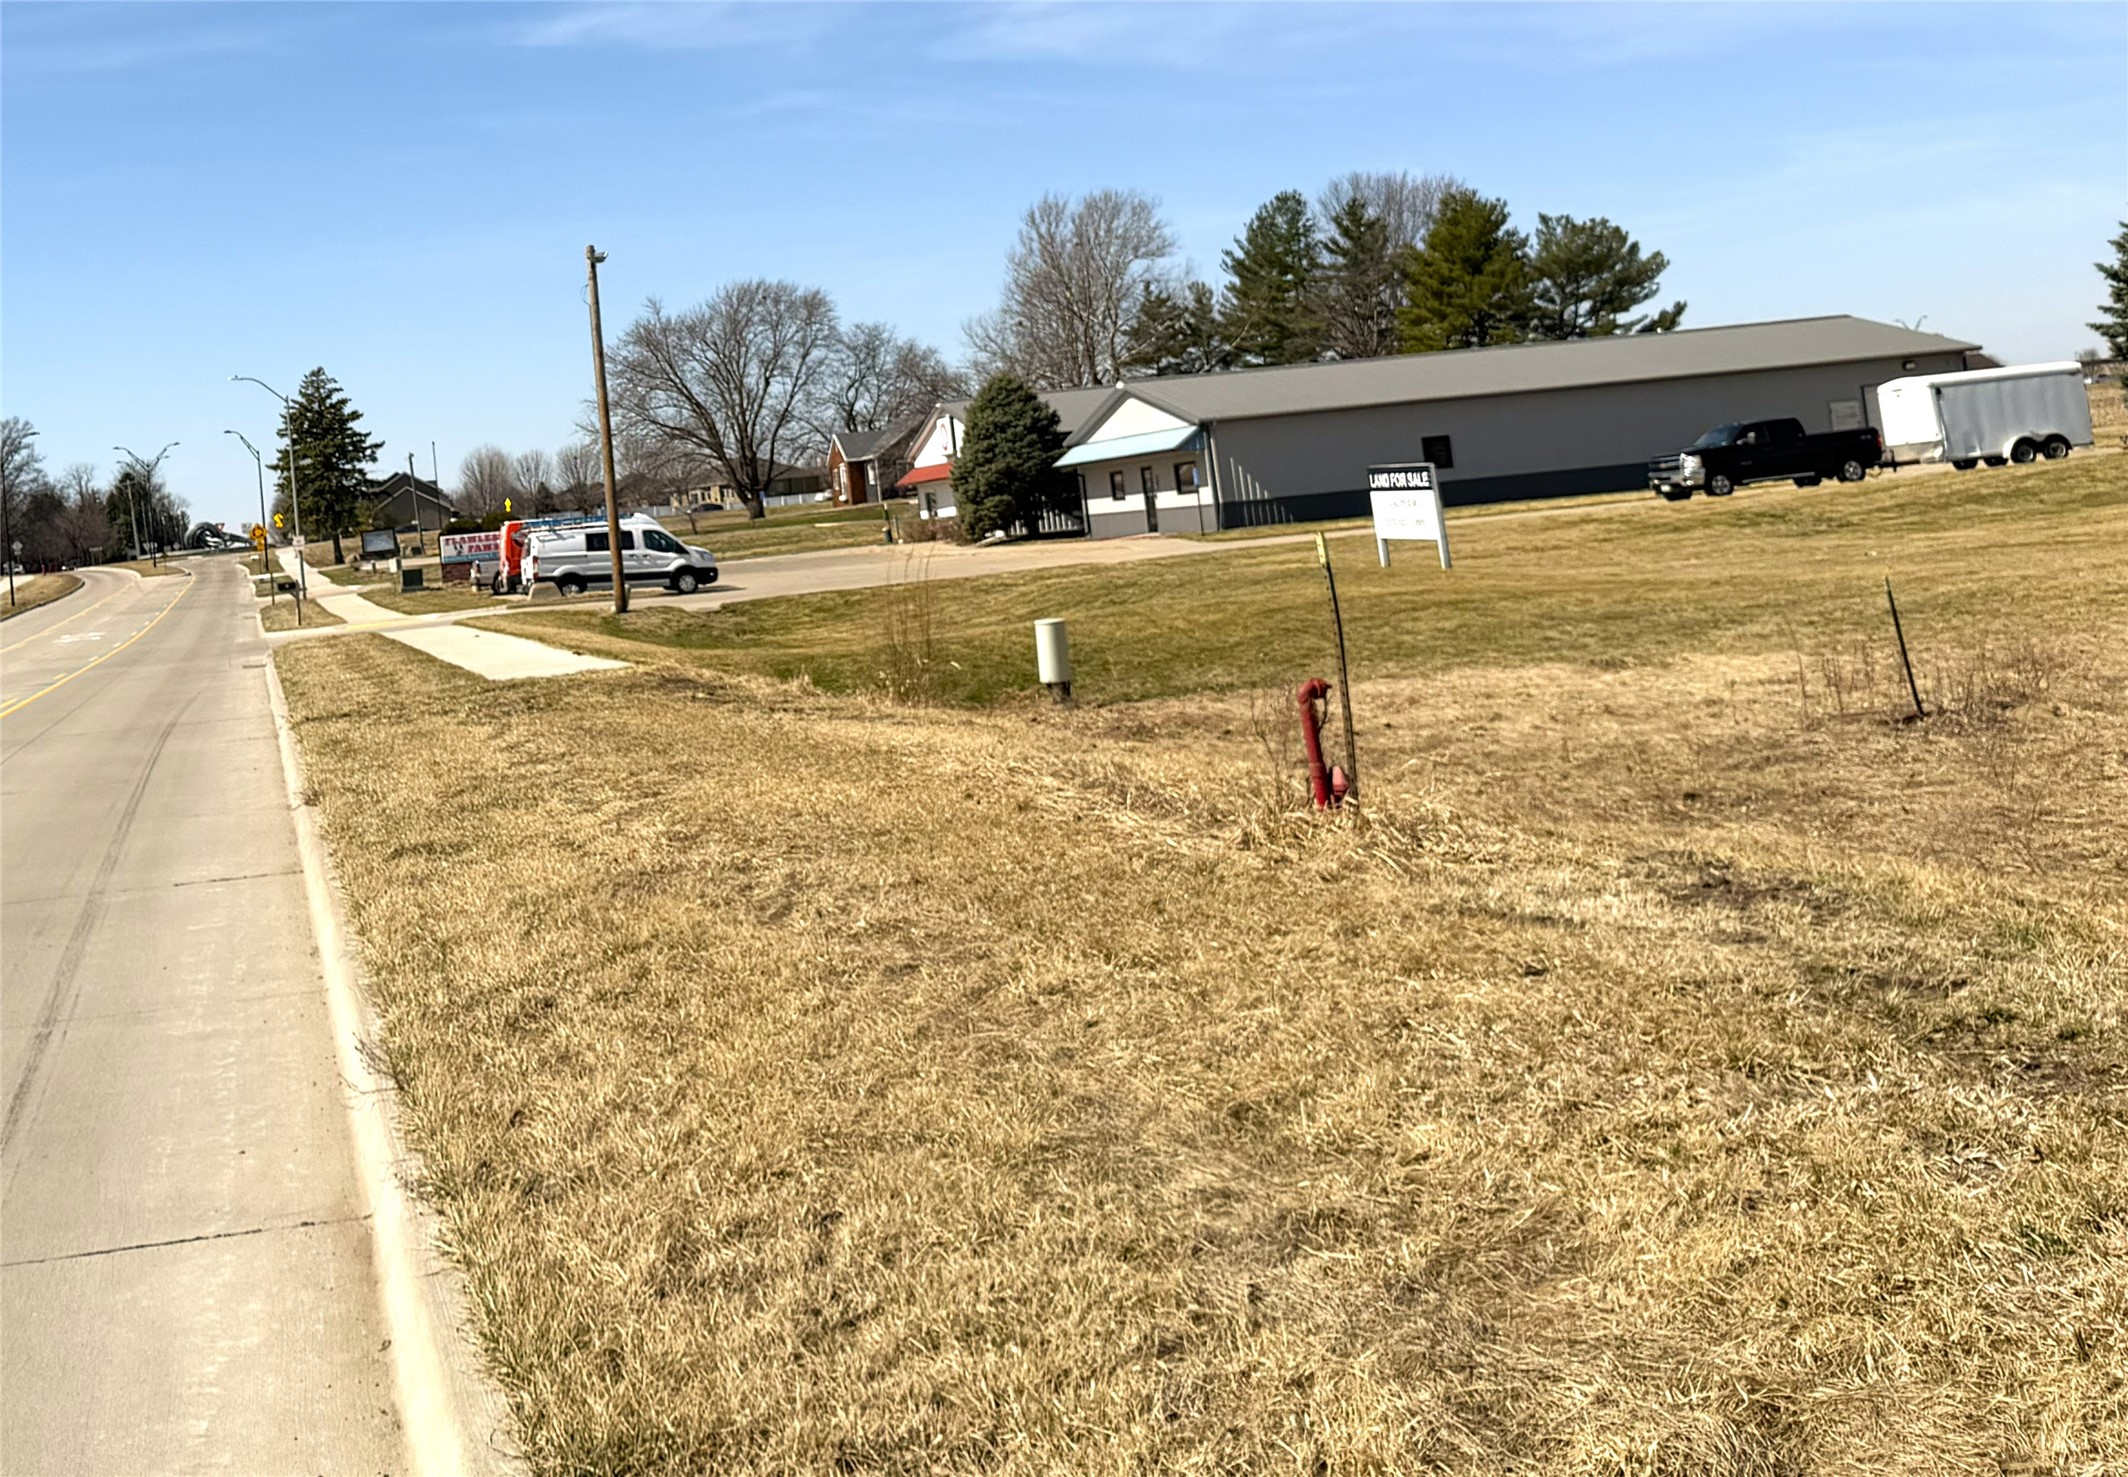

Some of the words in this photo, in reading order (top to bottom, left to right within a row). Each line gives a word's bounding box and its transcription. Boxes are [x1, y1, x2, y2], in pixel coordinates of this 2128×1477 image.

[1369, 472, 1390, 488] LAND
[1390, 472, 1407, 488] FOR
[1406, 471, 1430, 487] SALE
[445, 534, 501, 545] FLAWLES
